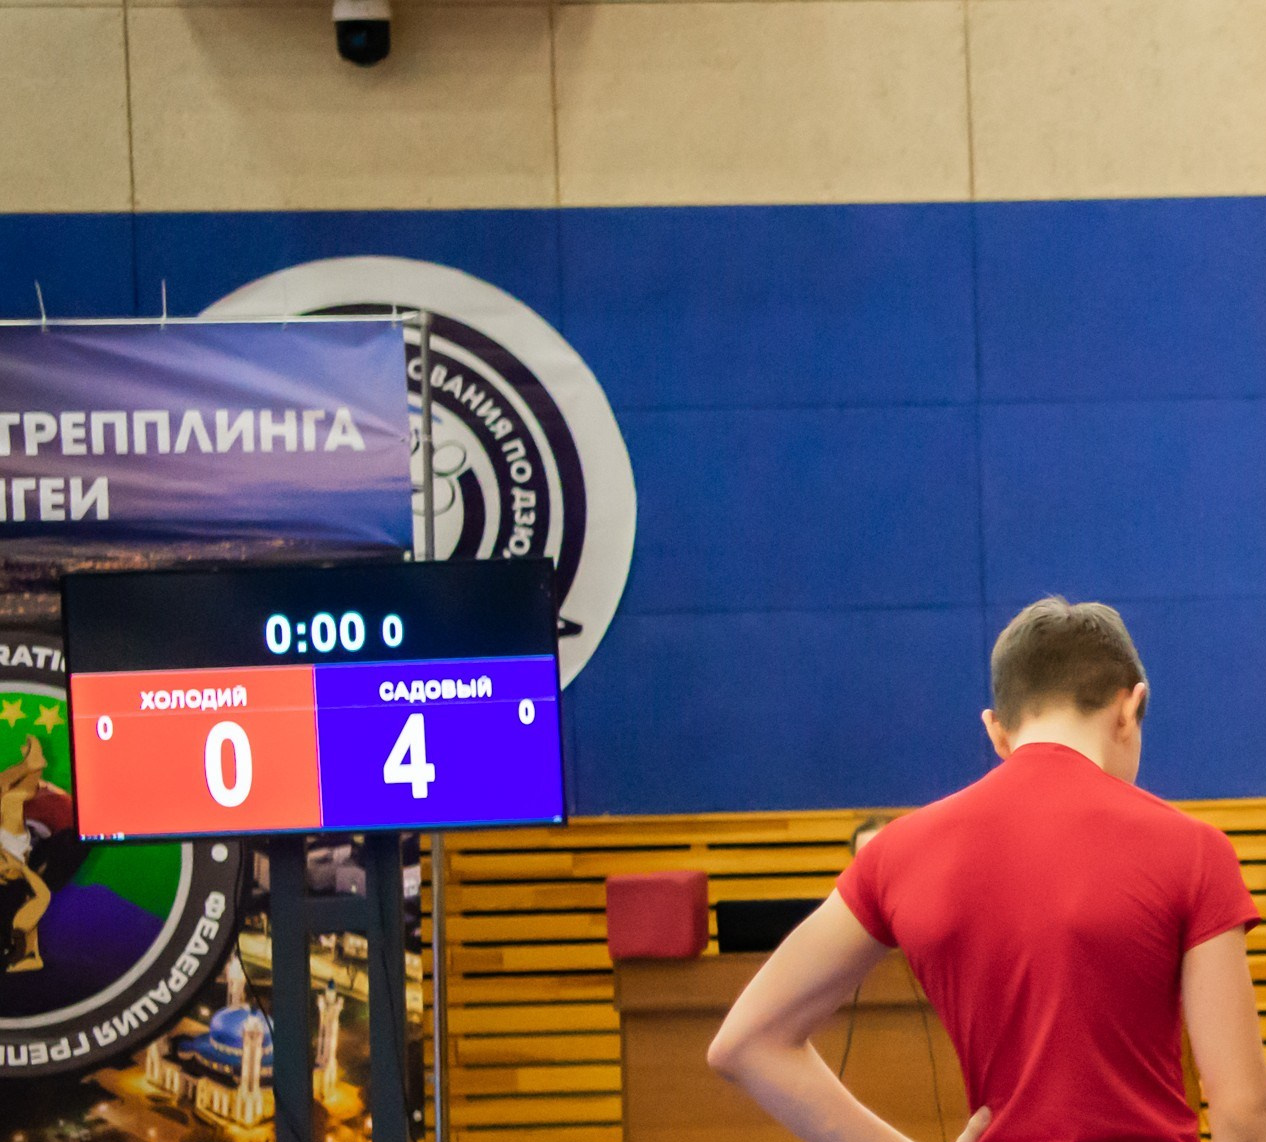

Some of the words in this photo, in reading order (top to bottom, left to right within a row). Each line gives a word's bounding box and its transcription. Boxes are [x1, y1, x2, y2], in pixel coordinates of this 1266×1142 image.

[502, 438, 532, 484] ПО
[0, 476, 110, 522] ГЕИ
[503, 487, 537, 559] ДЗЮ
[265, 612, 366, 655] 0:00
[381, 614, 404, 648] 0
[0, 644, 66, 673] RATI
[140, 685, 248, 712] ХОЛОДИЙ
[379, 675, 493, 703] САДОВЫЙ
[96, 715, 114, 742] 0
[203, 720, 253, 808] 0
[383, 712, 436, 800] 4
[518, 698, 536, 726] 0
[92, 891, 226, 1047] ФЕДЕРАЦИЯ
[0, 1031, 91, 1067] ГРЕП
